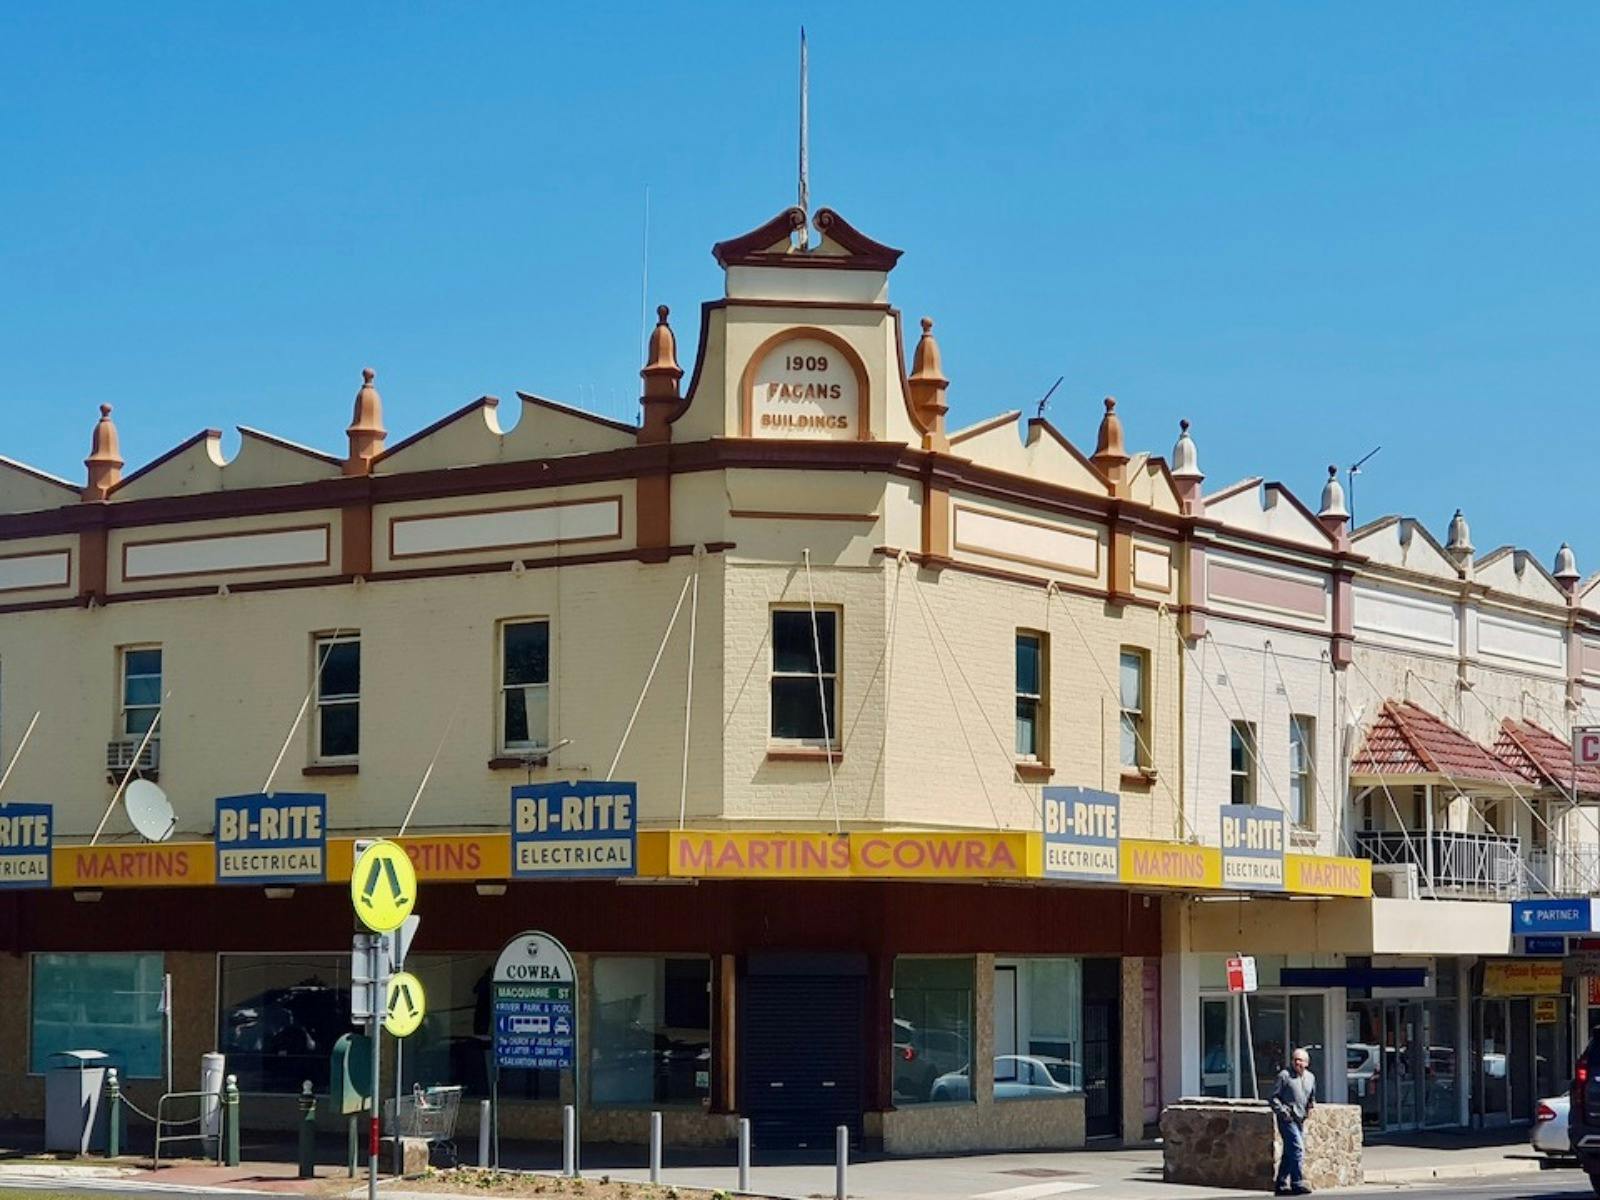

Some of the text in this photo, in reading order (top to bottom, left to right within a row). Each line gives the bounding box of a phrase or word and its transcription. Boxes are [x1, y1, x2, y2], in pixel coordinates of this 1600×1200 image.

[786, 356, 828, 371] 1909
[768, 383, 841, 399] FAGANS
[761, 414, 848, 429] BUILDINGS
[220, 806, 321, 841] BI-RITE
[516, 795, 632, 833] BI-RITE
[1045, 799, 1116, 840] BI-RITE
[1223, 816, 1282, 850] BI-RITE
[224, 854, 317, 871] ELECTRICAL
[405, 843, 481, 871] RTINS
[521, 846, 627, 864] ELECTRICAL
[680, 839, 1015, 869] MARTINS COWRA
[1049, 849, 1115, 869] ELECTRICAL
[77, 851, 188, 878] MARTINS
[1133, 850, 1204, 880] MARTINS
[1226, 862, 1280, 879] ELECTRICAL
[1301, 863, 1361, 889] MARTINS
[1536, 909, 1579, 920] PARTNER
[506, 965, 560, 979] COWRA
[498, 987, 569, 999] MACQUARIE ST
[523, 1003, 542, 1012] PARK
